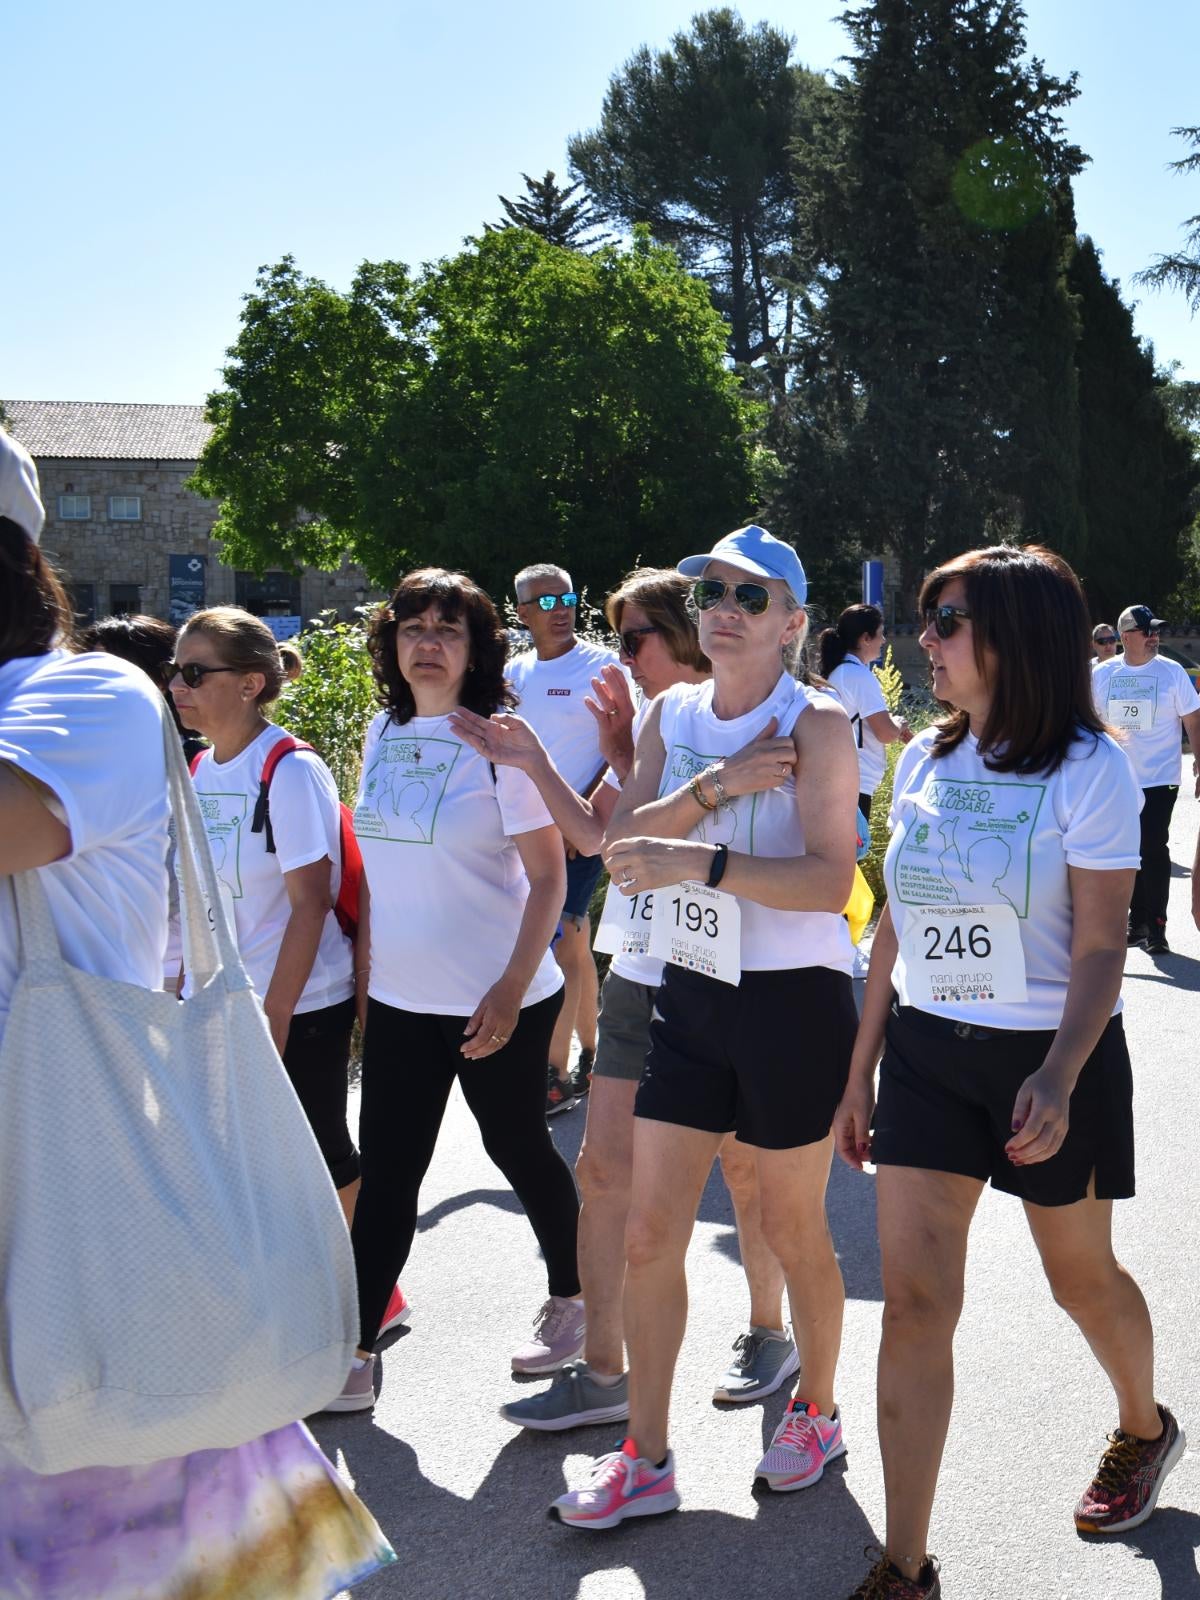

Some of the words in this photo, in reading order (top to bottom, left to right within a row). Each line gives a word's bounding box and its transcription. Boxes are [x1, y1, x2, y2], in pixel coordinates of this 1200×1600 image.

[1122, 706, 1139, 717] 79
[945, 786, 991, 802] PASEO
[928, 797, 996, 815] SALUDABLE
[910, 866, 930, 874] FAVOR
[901, 882, 953, 893] HOSPITALIZADOS
[911, 890, 950, 901] SALAMANCA
[672, 897, 718, 938] 193
[623, 940, 649, 948] EMPRES
[671, 937, 689, 951] nani
[691, 943, 717, 959] grupo
[924, 924, 992, 960] 246
[671, 947, 717, 968] EMPRESARIAL
[930, 973, 953, 984] nani
[956, 971, 993, 986] grupo
[931, 983, 994, 995] EMPRESARIAL
